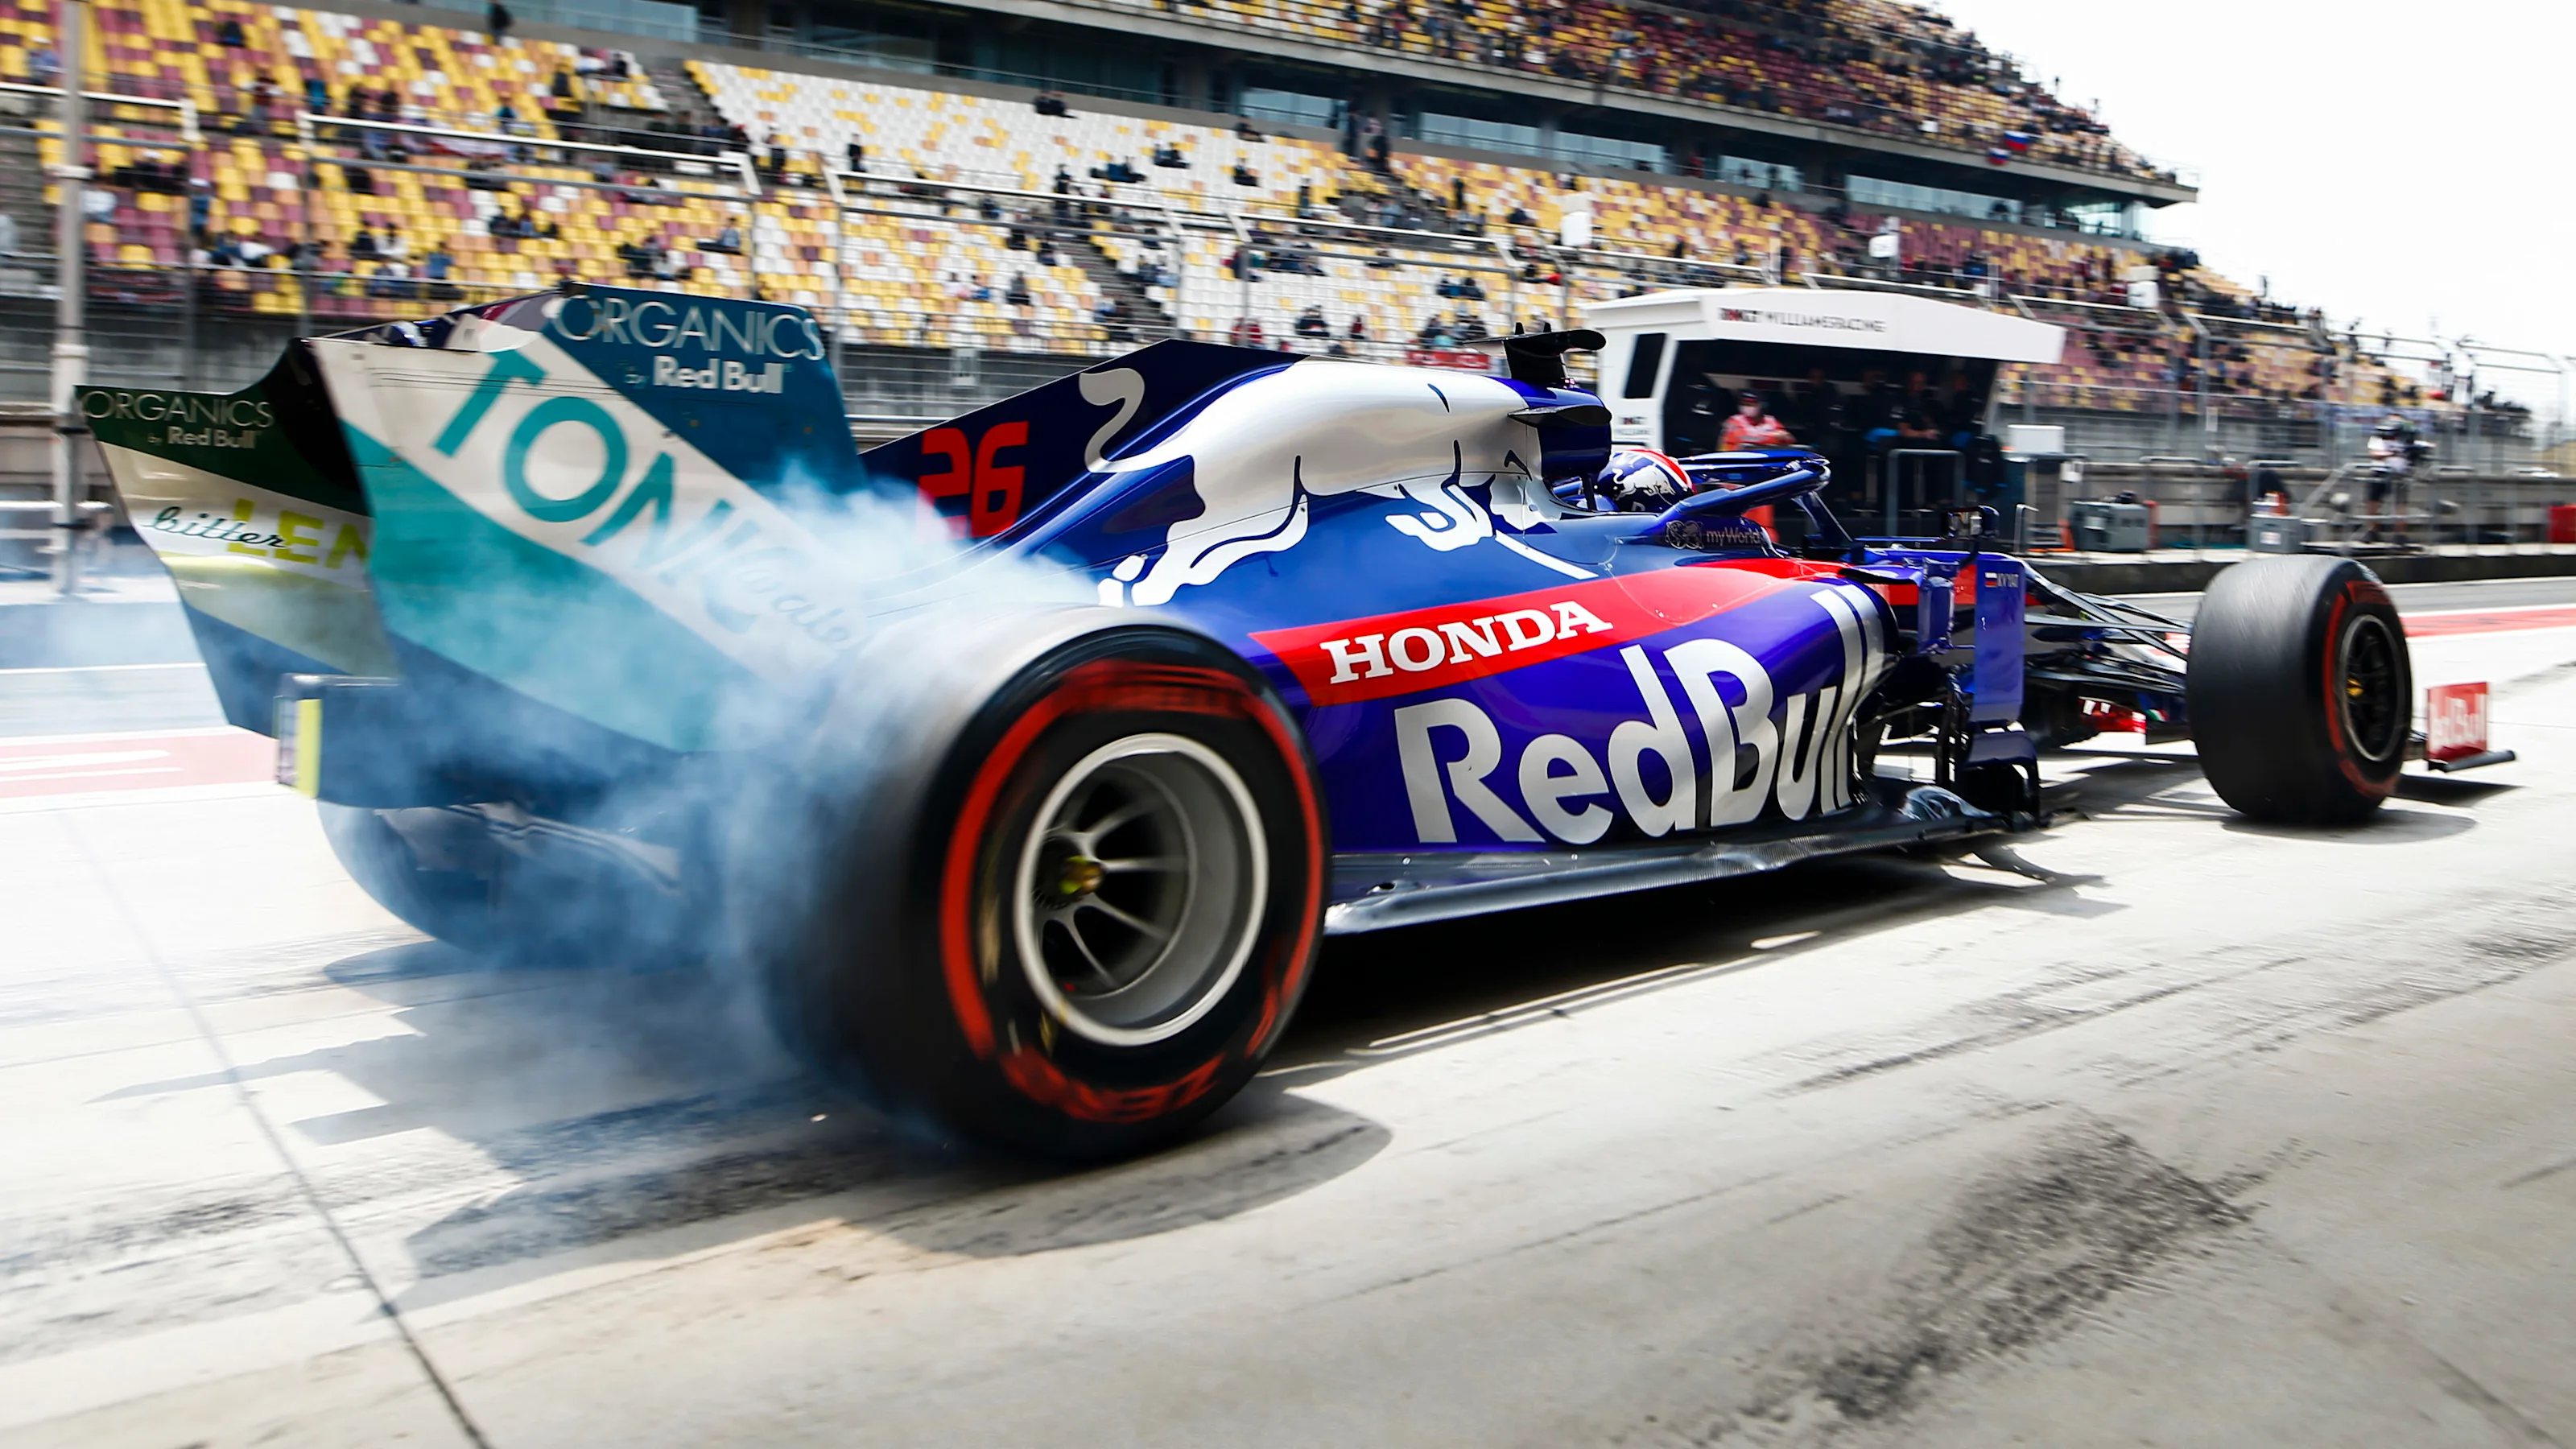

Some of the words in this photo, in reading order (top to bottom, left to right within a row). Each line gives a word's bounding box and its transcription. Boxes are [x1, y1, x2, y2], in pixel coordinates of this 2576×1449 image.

[550, 295, 826, 361] ORGANICS
[653, 355, 720, 390] Red
[722, 361, 784, 394] Bull
[81, 390, 275, 428] ORGANICS
[167, 426, 212, 446] Red
[213, 429, 256, 449] Bull
[914, 421, 1030, 544] 26
[140, 505, 292, 548] bitter
[1706, 526, 1761, 547] myWorld
[1319, 601, 1613, 684] HONDA
